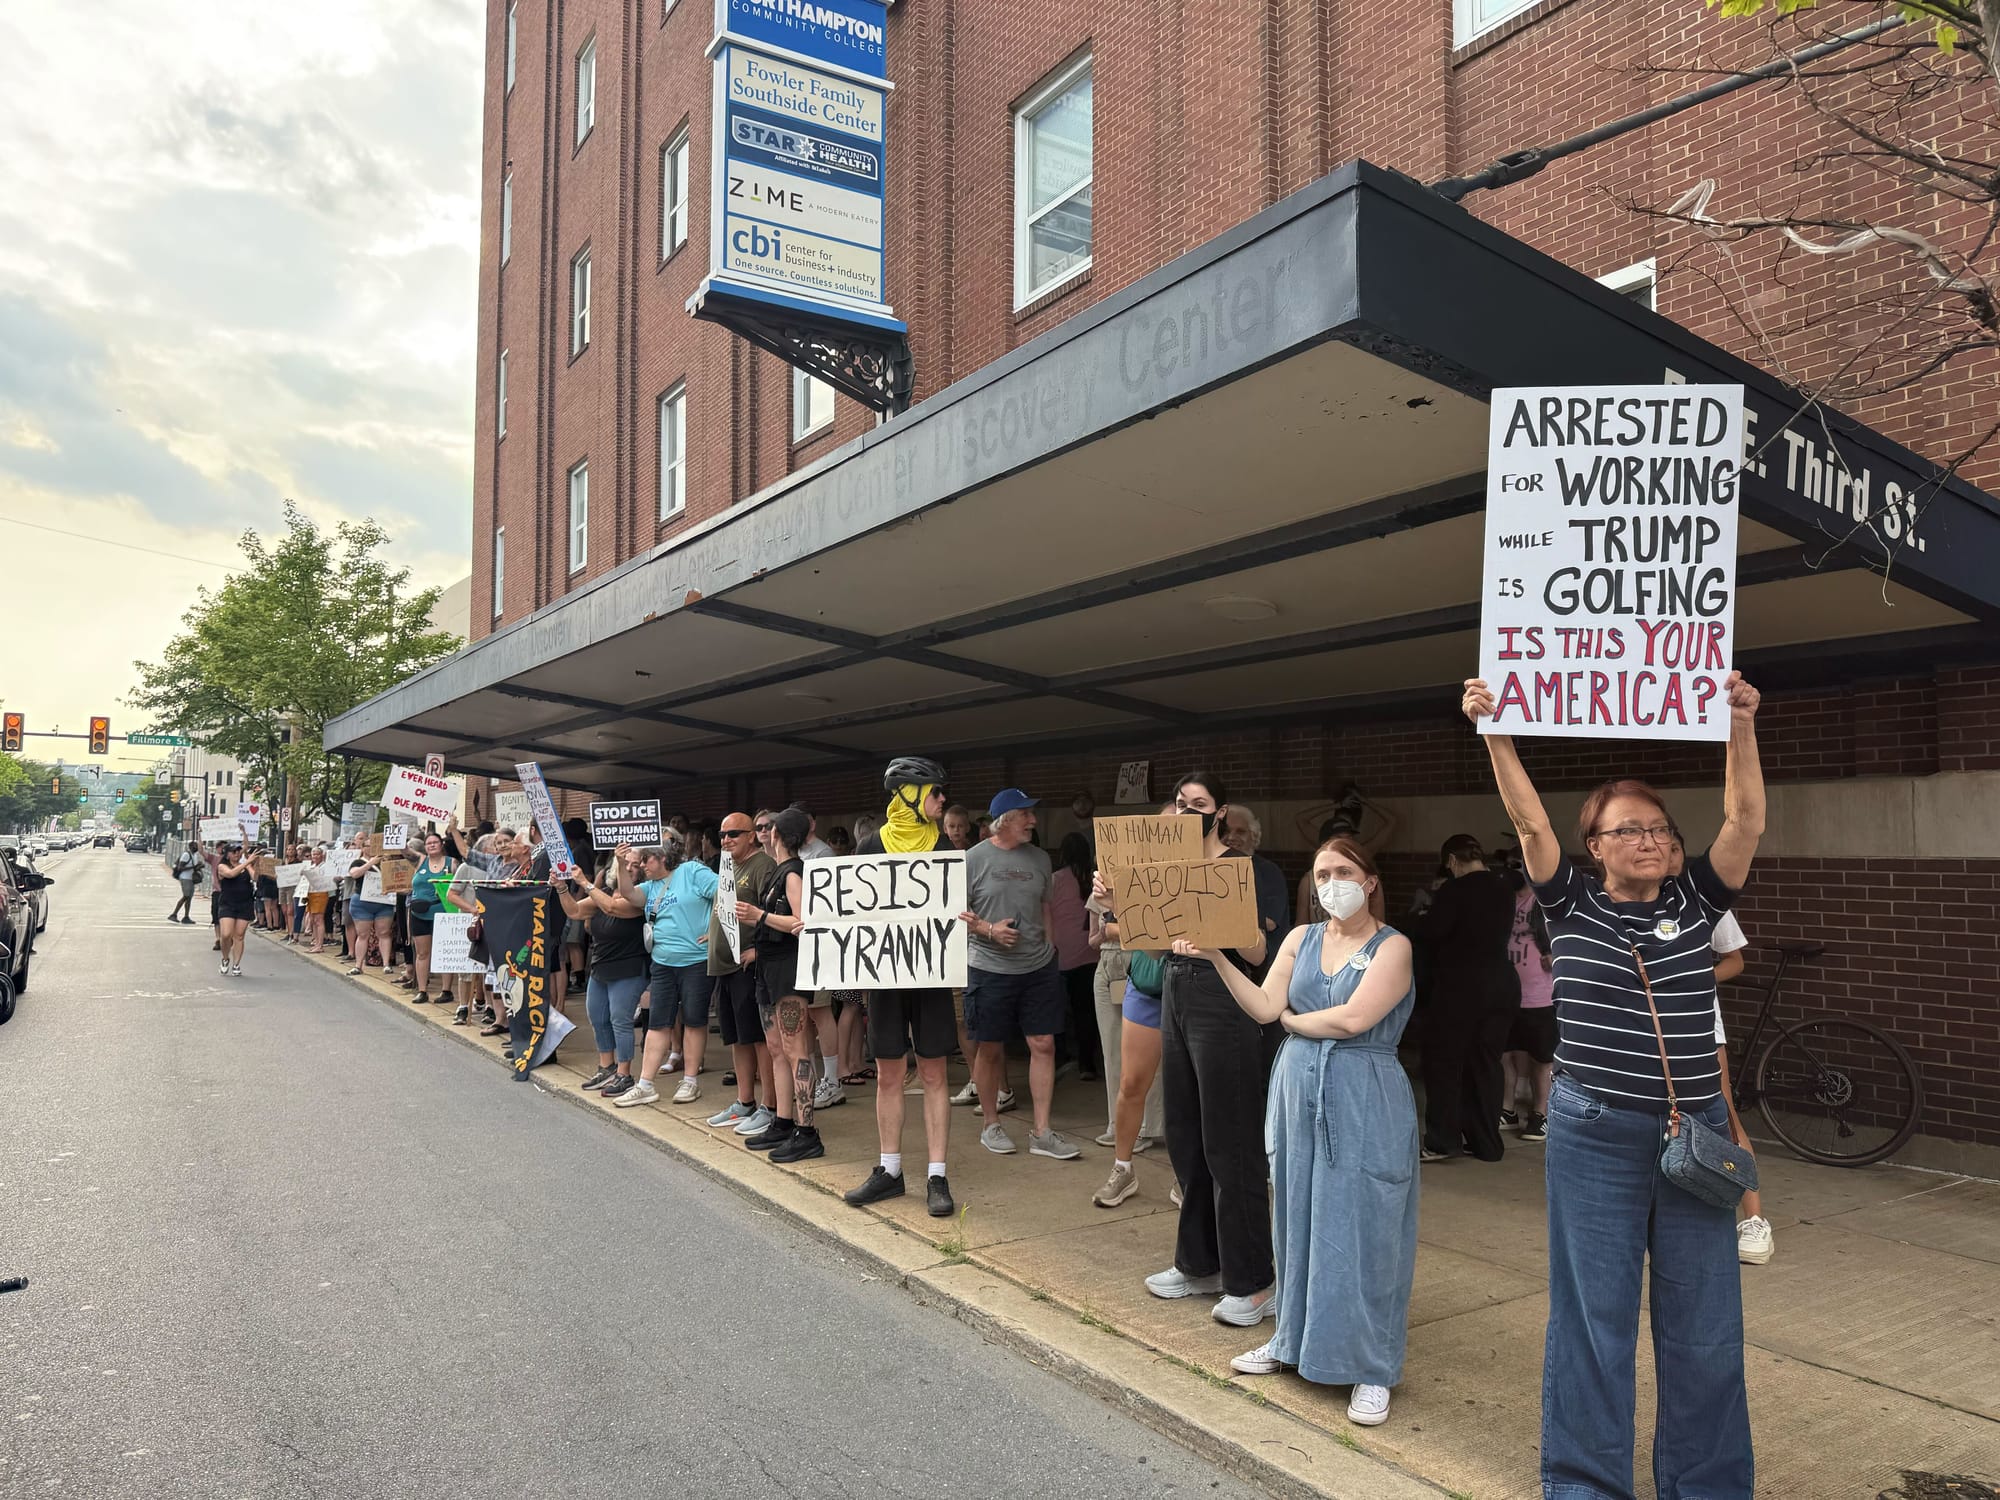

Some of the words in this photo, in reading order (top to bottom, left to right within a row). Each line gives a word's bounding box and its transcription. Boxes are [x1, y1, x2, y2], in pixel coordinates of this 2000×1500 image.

[732, 0, 816, 35] COMMUNITY
[824, 30, 883, 57] COLLEGE
[746, 59, 805, 92] Fowler
[809, 78, 865, 114] Family
[733, 77, 817, 116] Southside
[823, 104, 877, 134] Center
[738, 123, 795, 152] STAR
[819, 143, 872, 164] COMMUNITY
[819, 150, 872, 172] HEALTH
[729, 176, 804, 213] ZIME
[817, 205, 849, 218] MODERN
[851, 213, 879, 226] EATERY
[732, 225, 781, 261] cbi
[785, 243, 816, 257] center
[819, 249, 833, 262] for
[735, 257, 753, 270] One
[755, 263, 788, 278] source.
[790, 270, 833, 288] Countless
[834, 281, 877, 299] solutions.
[837, 265, 876, 286] industry
[1503, 396, 1728, 448] ARRESTED
[1501, 473, 1544, 493] FOR
[1554, 455, 1736, 507] WORKING
[1783, 428, 1871, 523] Third
[1883, 481, 1926, 553] St.
[1498, 531, 1555, 550] WHILE
[1568, 515, 1721, 564] TRUMP
[1498, 577, 1525, 598] IS
[1543, 565, 1728, 617] GOLFING
[1497, 626, 1546, 661] IS
[1554, 627, 1626, 660] THIS
[1635, 618, 1726, 671] YOUR
[1492, 670, 1718, 726] AMERICA?
[132, 735, 171, 745] Fillmore
[176, 737, 187, 745] St
[401, 770, 423, 785] EVER
[424, 776, 448, 790] HEARD
[415, 788, 427, 798] OF
[393, 796, 411, 809] DUE
[412, 801, 449, 821] PROCESS?
[500, 812, 511, 822] DUE
[594, 806, 630, 820] STOP
[632, 804, 656, 818] ICE
[384, 836, 400, 846] ICE
[544, 831, 559, 841] THE
[595, 826, 618, 836] STOP
[619, 824, 658, 835] HUMAN
[596, 833, 659, 844] TRAFFICKING
[1099, 821, 1119, 845] NO
[1125, 817, 1183, 846] HUMAN
[809, 858, 964, 917] RESIST
[1126, 863, 1249, 902] ABOLISH
[531, 897, 546, 969] MAKE
[804, 917, 957, 986] TYRANNY
